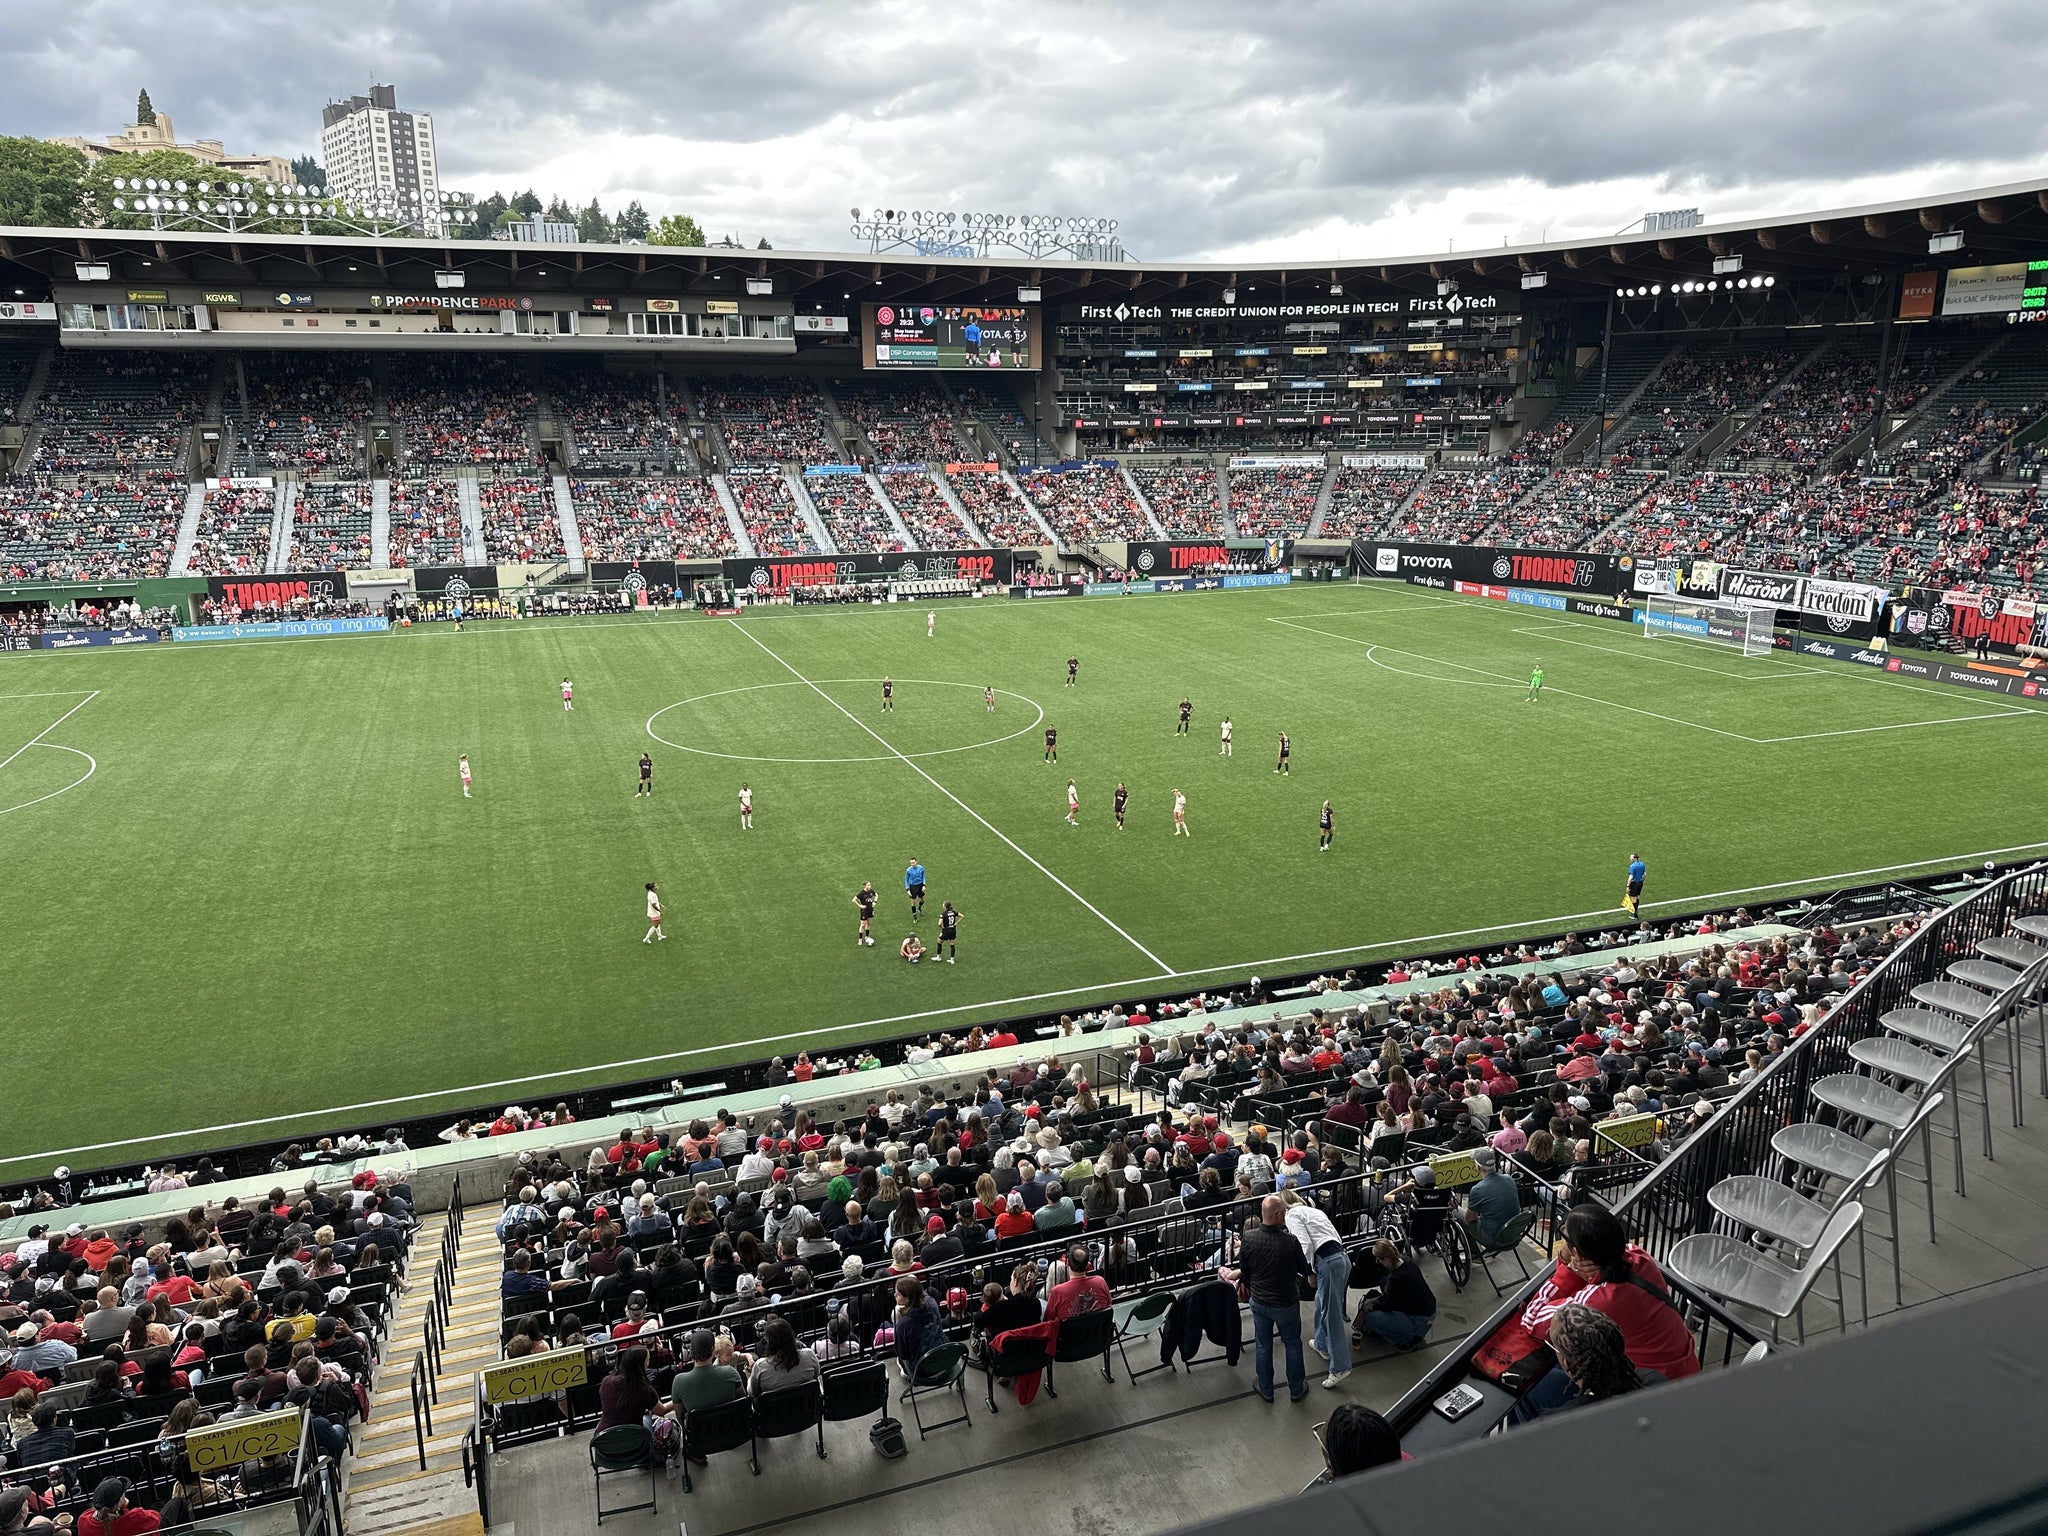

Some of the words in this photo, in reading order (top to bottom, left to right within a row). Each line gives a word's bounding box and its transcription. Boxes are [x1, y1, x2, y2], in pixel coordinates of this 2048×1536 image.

[1995, 273, 2026, 283] GMC
[1904, 287, 1933, 296] REYKA
[1963, 294, 1979, 304] GMC
[1980, 293, 1988, 301] of
[1988, 293, 2024, 302] Beaverton
[385, 295, 480, 309] PROVIDENCE
[479, 297, 517, 309] PARK
[1409, 298, 1443, 311] First
[1463, 295, 1497, 309] Tech
[1081, 305, 1112, 319] First
[1131, 305, 1162, 319] Tech
[1170, 308, 1193, 318] THE
[1195, 307, 1237, 318] CREDIT
[1239, 306, 1277, 317] UNION
[1279, 306, 1303, 316] FOR
[1305, 304, 1350, 316] PEOPLE
[1352, 304, 1365, 314] IN
[1367, 302, 1399, 314] TECH
[232, 479, 260, 487] TOYOTA
[1169, 546, 1229, 570] THORNS
[1401, 555, 1453, 570] TOYOTA
[769, 562, 836, 586] THORNS
[835, 561, 857, 583] FC
[957, 555, 994, 580] 2012
[1511, 555, 1575, 585] THORNS
[1571, 559, 1596, 587] FC
[1413, 575, 1427, 585] First
[1432, 579, 1446, 588] Tech
[1656, 571, 1667, 582] THE
[1033, 588, 1070, 596] Nationwide
[1462, 584, 1479, 593] TOYOTA
[1489, 588, 1506, 597] TOYOTA
[1729, 573, 1795, 601] HISTORY
[222, 581, 309, 611] THORNS
[1508, 590, 1520, 602] ring
[1521, 593, 1534, 604] ring
[1538, 595, 1551, 607] ring
[1552, 598, 1566, 610] ring
[1576, 602, 1594, 613] First
[1601, 606, 1620, 617] Tech
[285, 623, 307, 634] ring
[310, 621, 332, 633] ring
[341, 619, 363, 632] ring
[365, 617, 388, 630] ring
[1649, 618, 1665, 627] KAISER
[1709, 626, 1733, 637] KeyBank
[1751, 633, 1777, 645] KeyBank
[51, 637, 91, 648] Tillamook
[109, 634, 149, 646] Tillamook
[1803, 641, 1836, 657] Alaska
[1850, 649, 1885, 666] Alaska
[1900, 663, 1927, 674] TOYOTA
[1949, 671, 1999, 687] TOYOTA.COM
[500, 1366, 520, 1375] SEATS
[550, 1356, 570, 1364] SEATS
[508, 1364, 585, 1396] C1/C2
[191, 1436, 201, 1444] C1
[201, 1432, 226, 1441] SEATS
[260, 1419, 283, 1429] SEATS
[284, 1416, 297, 1424] 1-8
[195, 1433, 280, 1466] C1/C2
